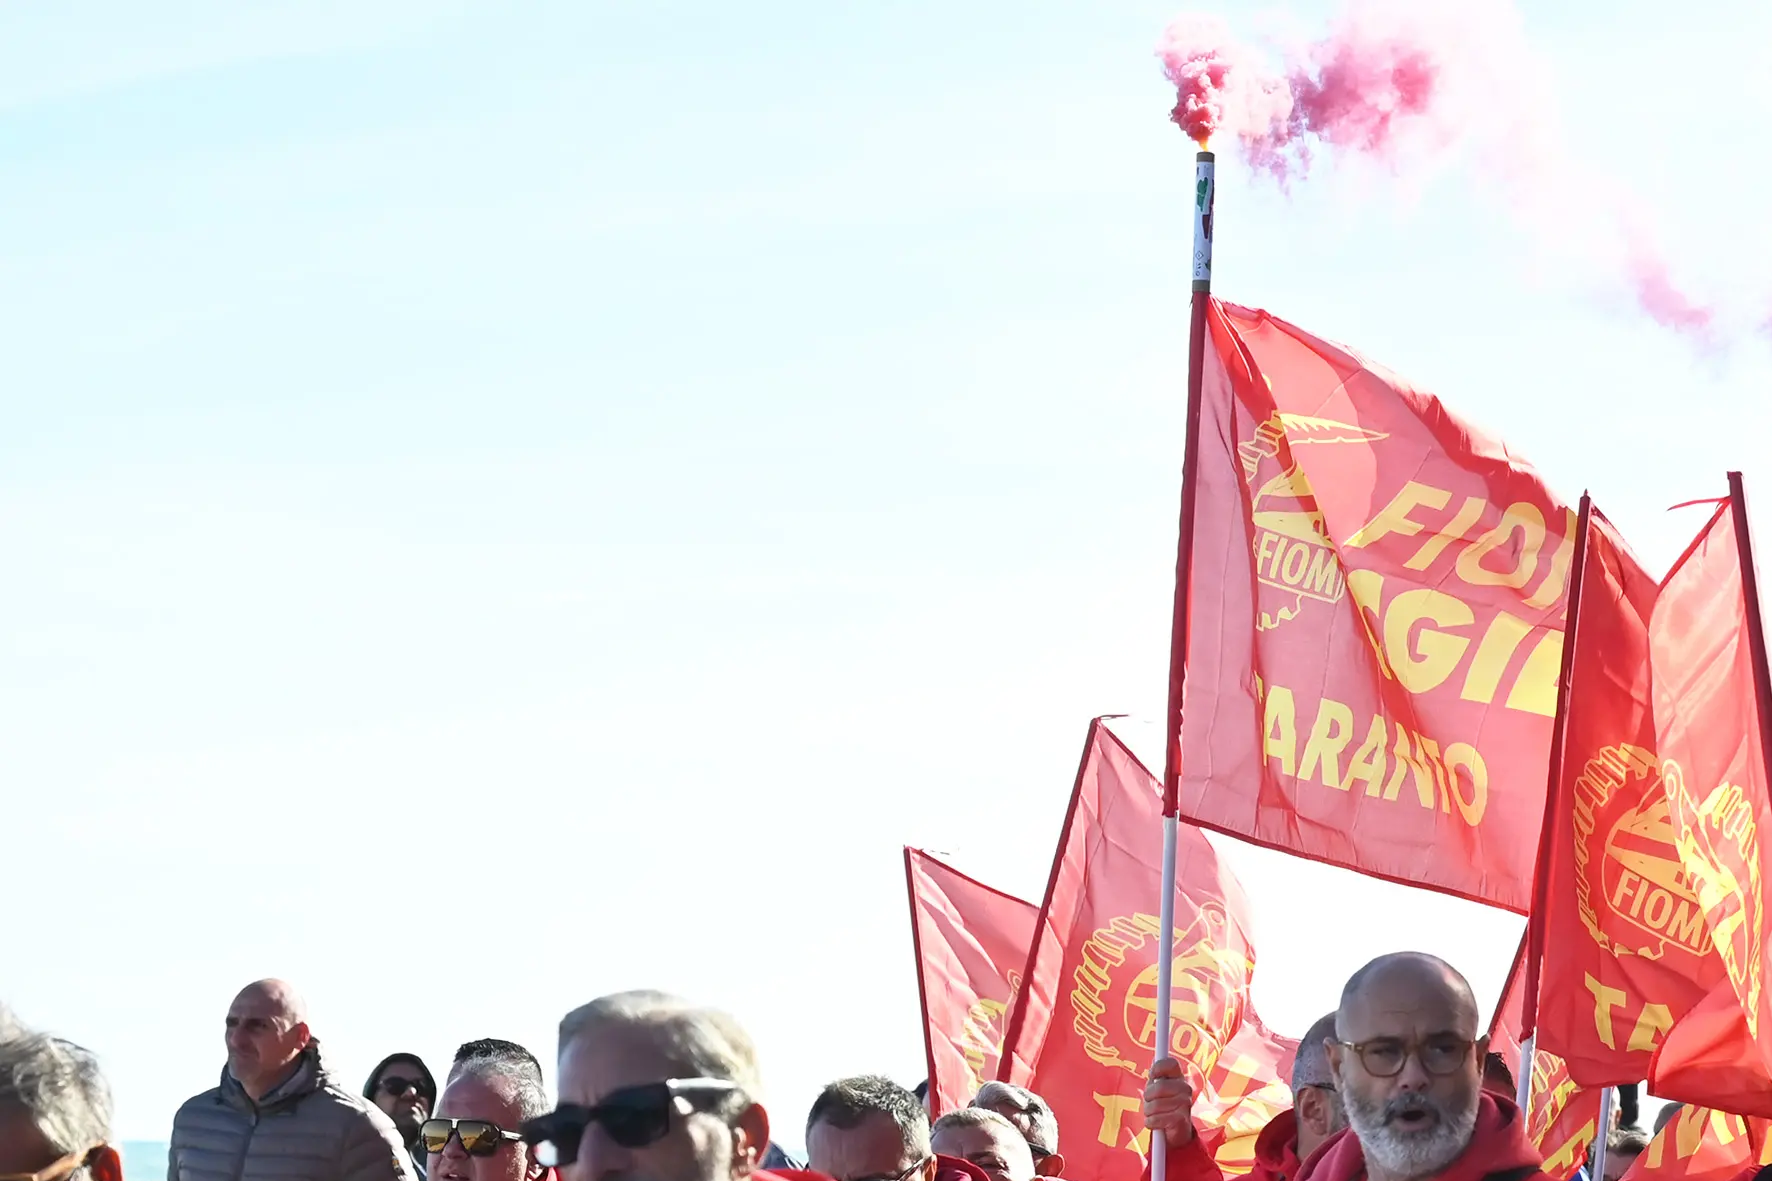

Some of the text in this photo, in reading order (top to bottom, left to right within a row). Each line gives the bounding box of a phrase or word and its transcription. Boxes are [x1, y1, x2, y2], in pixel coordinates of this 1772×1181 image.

[1257, 532, 1338, 596] FIOM
[1254, 671, 1488, 827] ARANTO
[1612, 868, 1706, 949] FIOM
